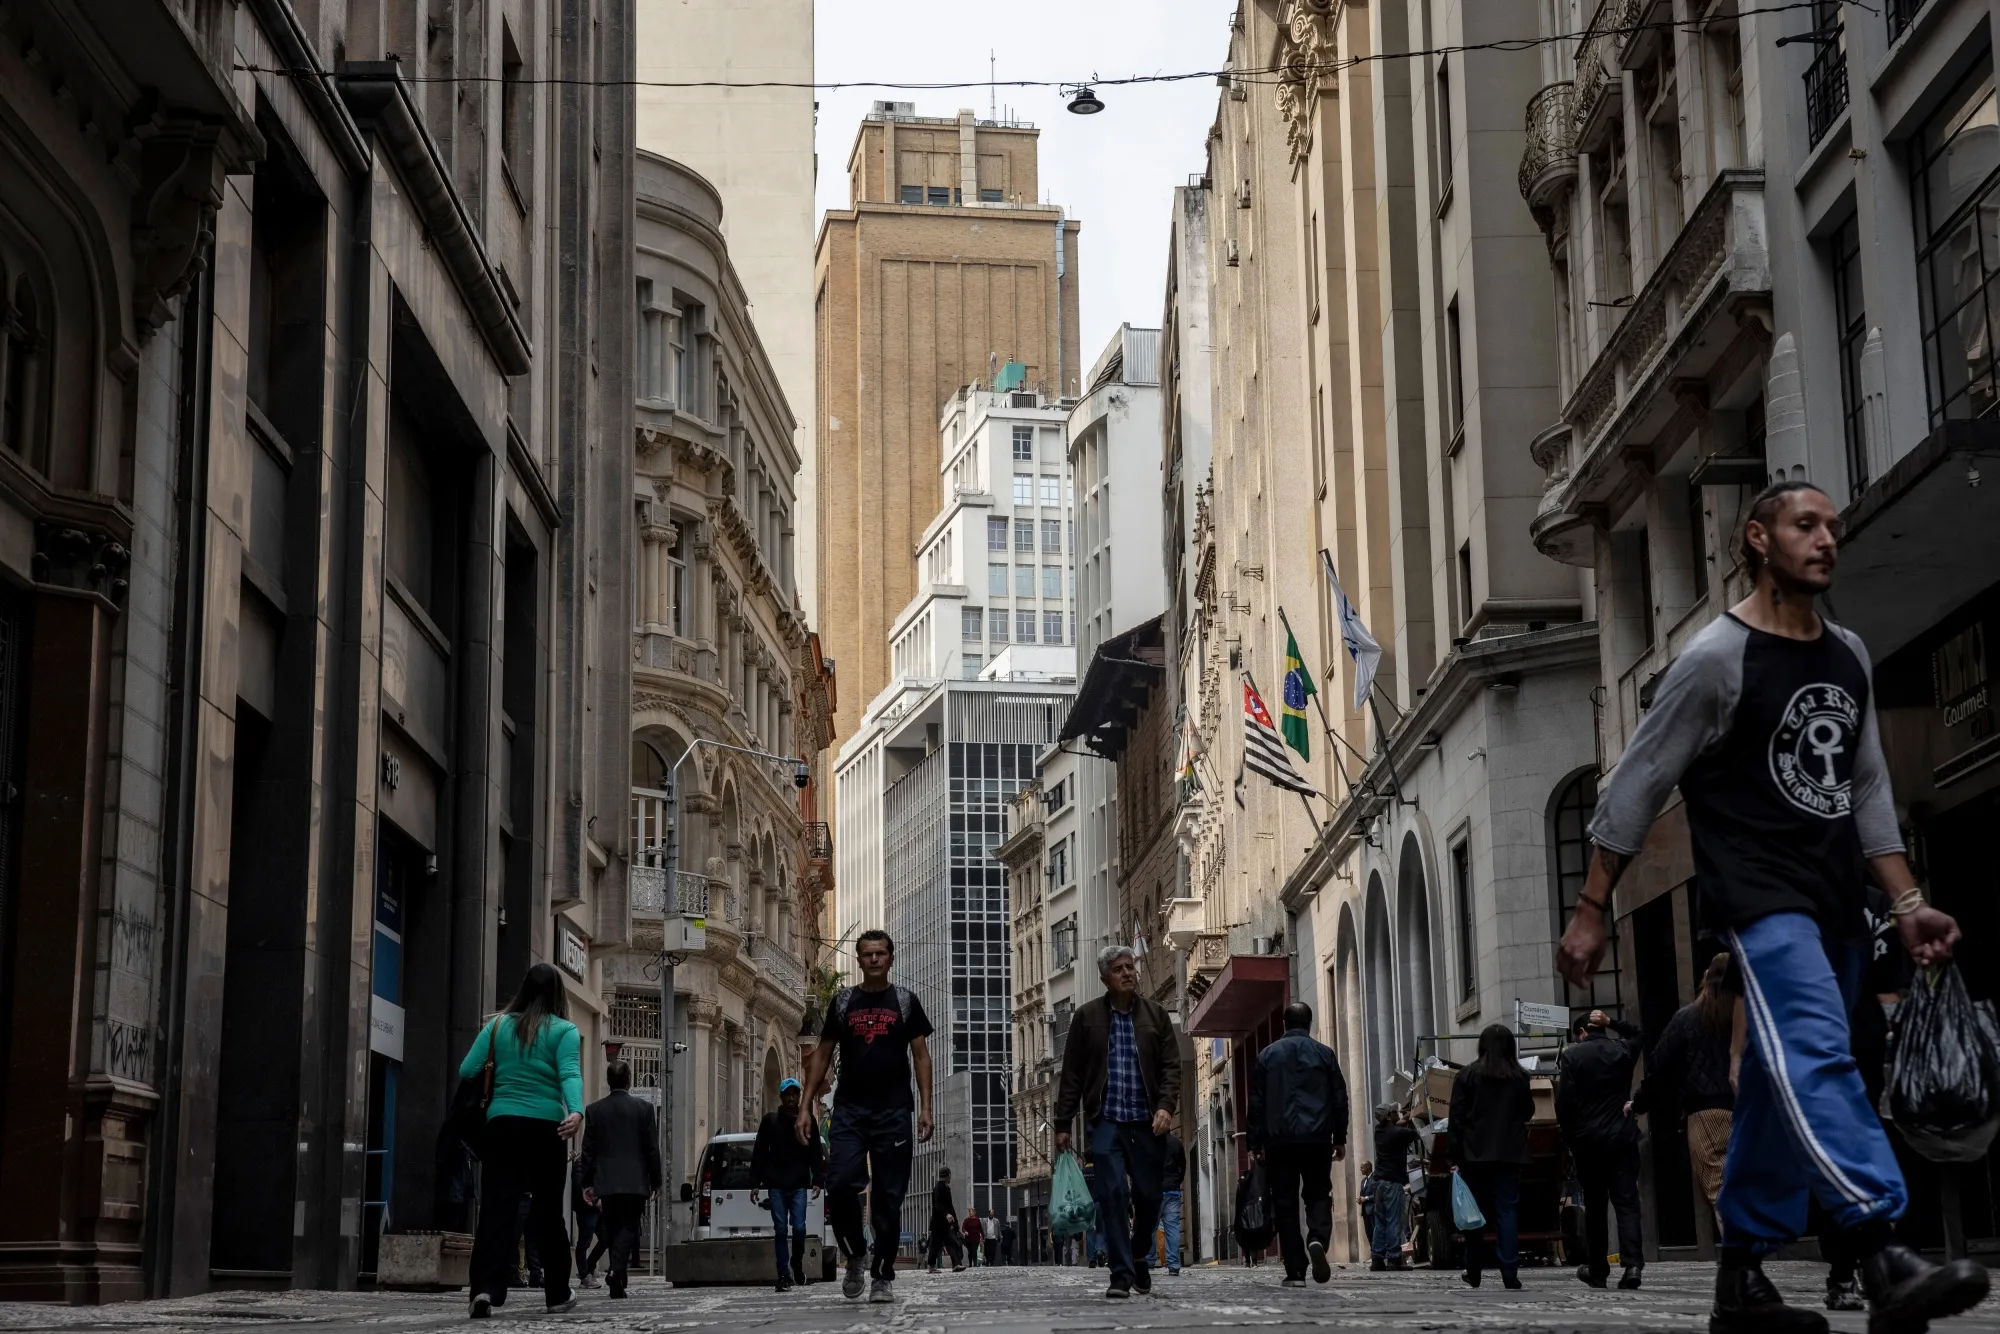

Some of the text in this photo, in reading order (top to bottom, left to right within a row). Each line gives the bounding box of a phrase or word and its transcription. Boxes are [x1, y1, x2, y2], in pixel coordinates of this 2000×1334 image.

[1943, 686, 1988, 727] Gourmet
[385, 750, 400, 790] 318
[848, 1014, 877, 1027] ATHLETIC
[1524, 1005, 1549, 1014] Comércio
